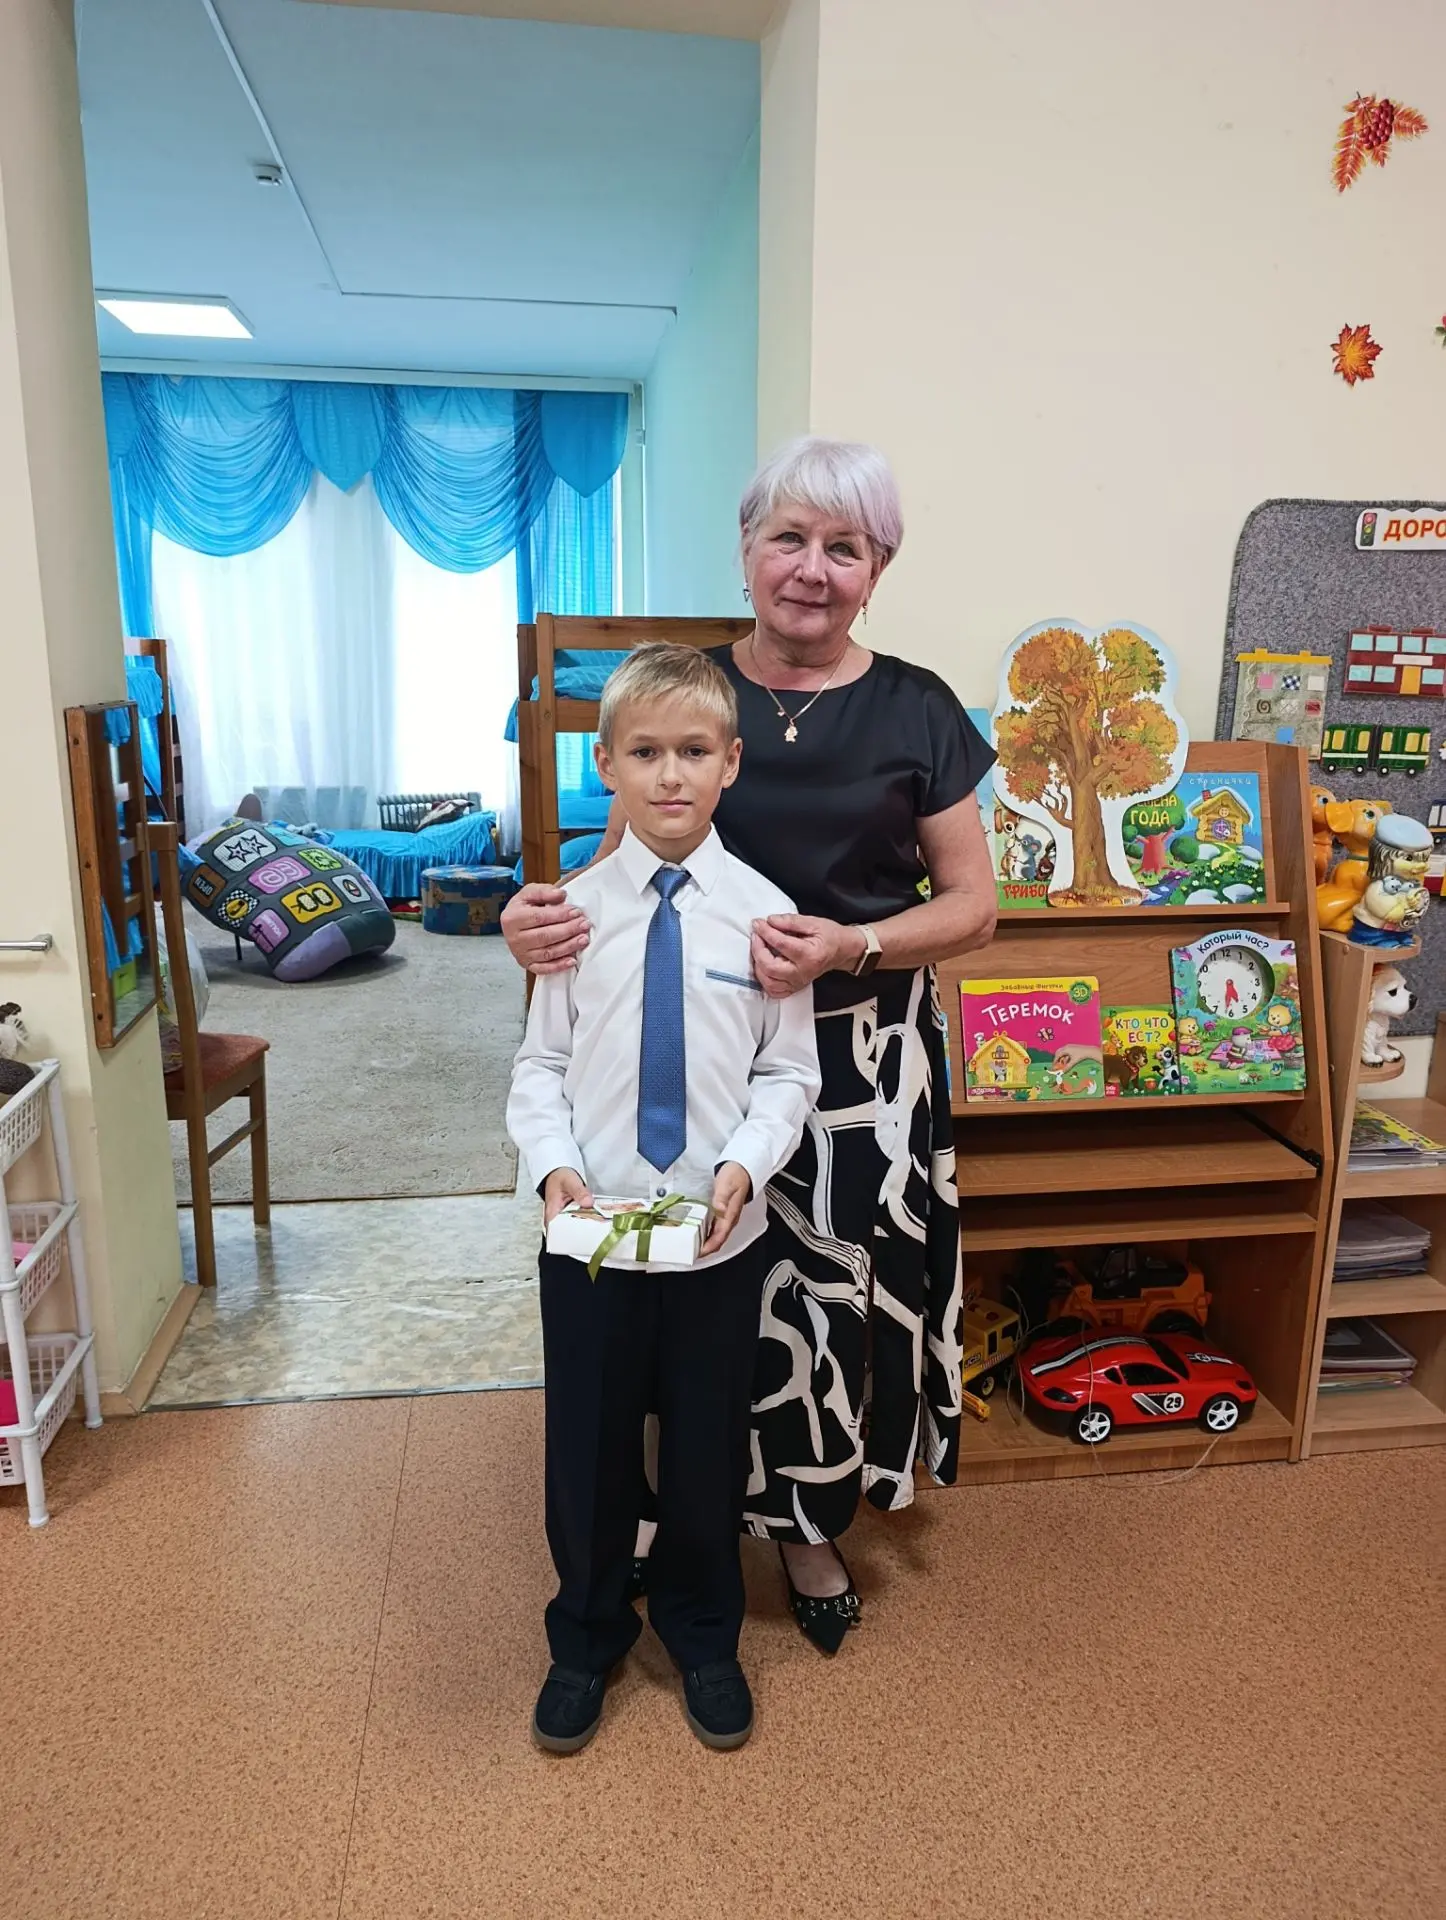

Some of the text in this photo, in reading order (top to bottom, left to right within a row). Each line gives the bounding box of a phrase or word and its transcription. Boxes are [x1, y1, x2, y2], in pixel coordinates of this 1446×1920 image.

[1383, 519, 1446, 541] ДОРО
[1130, 809, 1170, 827] ГОДА
[1003, 884, 1049, 899] ГРИБО
[1197, 931, 1270, 954] Который час?
[1222, 948, 1231, 958] 12
[1248, 961, 1254, 970] 2
[1254, 978, 1260, 987] 3
[1073, 986, 1088, 998] 3D
[1251, 993, 1257, 1001] 4
[1213, 1005, 1219, 1014] 7
[1228, 1009, 1234, 1018] 6
[1242, 1004, 1248, 1013] 5
[1115, 1016, 1169, 1029] КТО ЧТО
[1128, 1031, 1161, 1043] ЕСТ?
[1166, 1396, 1182, 1409] 29
